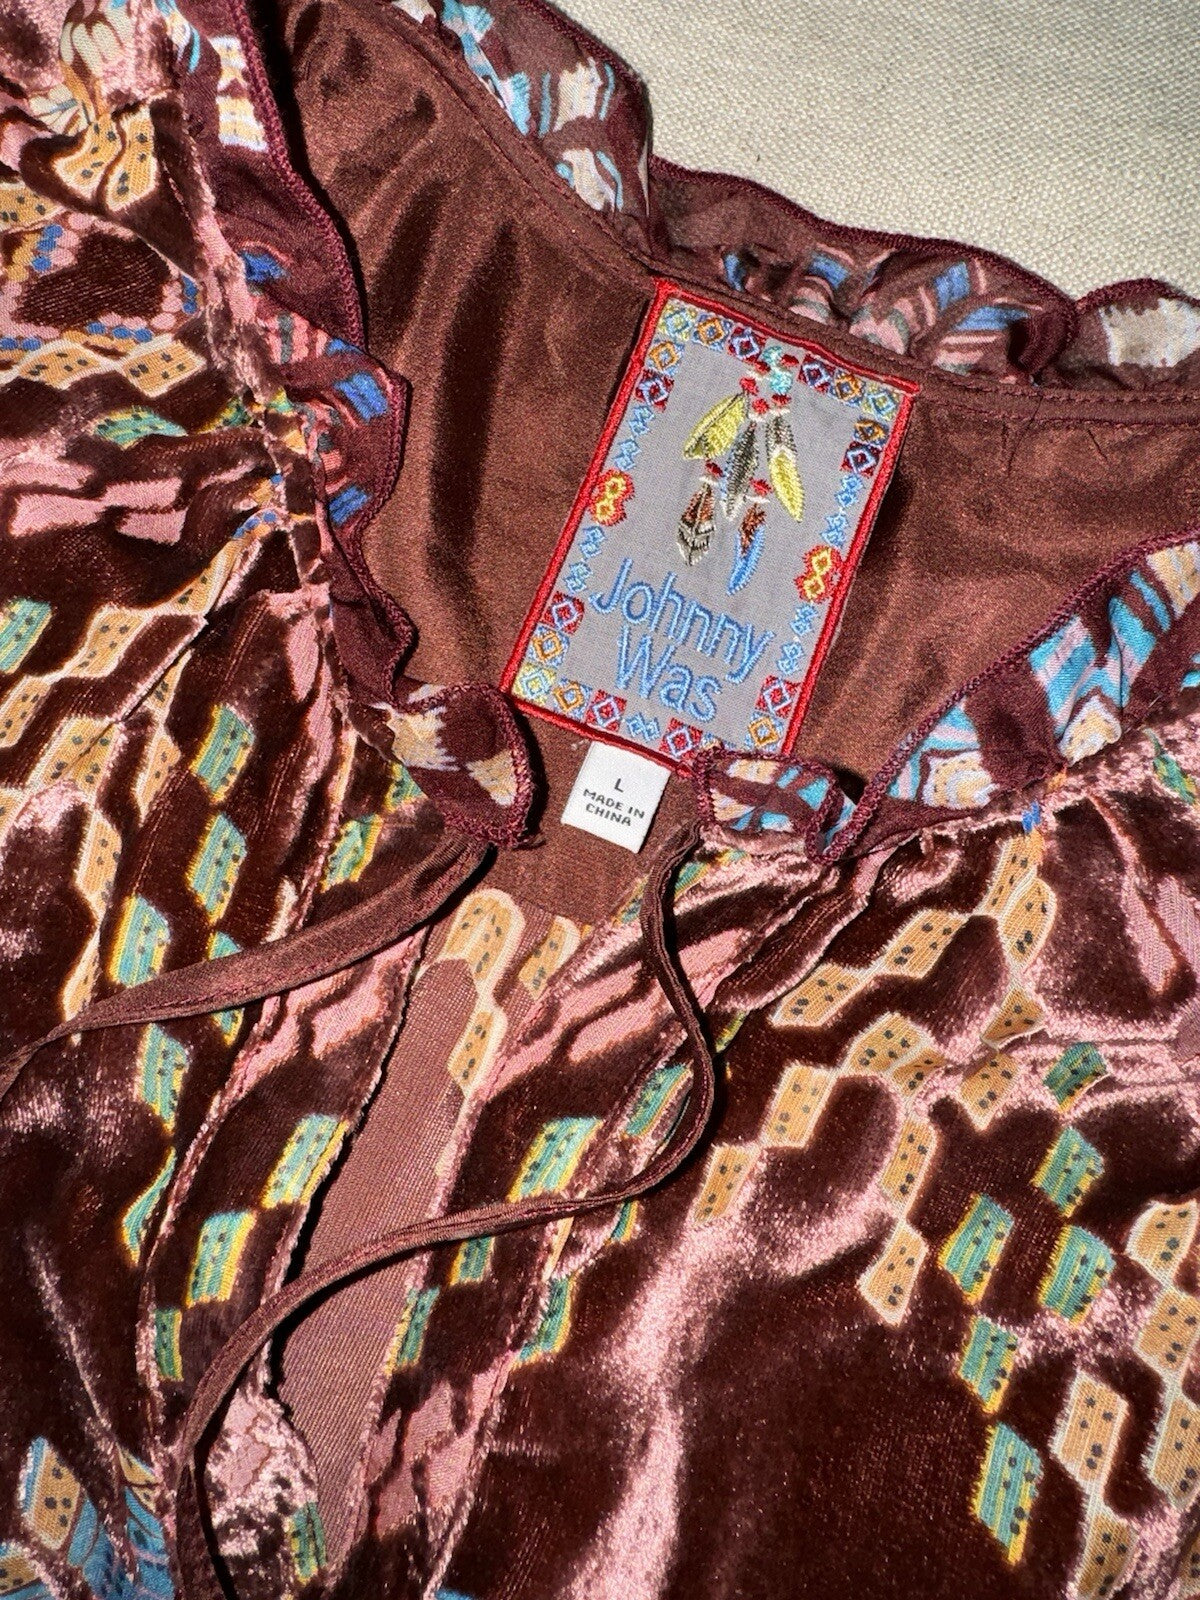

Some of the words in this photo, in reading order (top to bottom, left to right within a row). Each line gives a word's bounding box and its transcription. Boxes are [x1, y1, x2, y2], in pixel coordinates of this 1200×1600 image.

[588, 558, 776, 684] Johnny
[616, 624, 722, 722] Was
[614, 778, 624, 793] L
[583, 788, 624, 811] MADE
[628, 806, 645, 819] IN
[585, 803, 632, 827] CHINA
